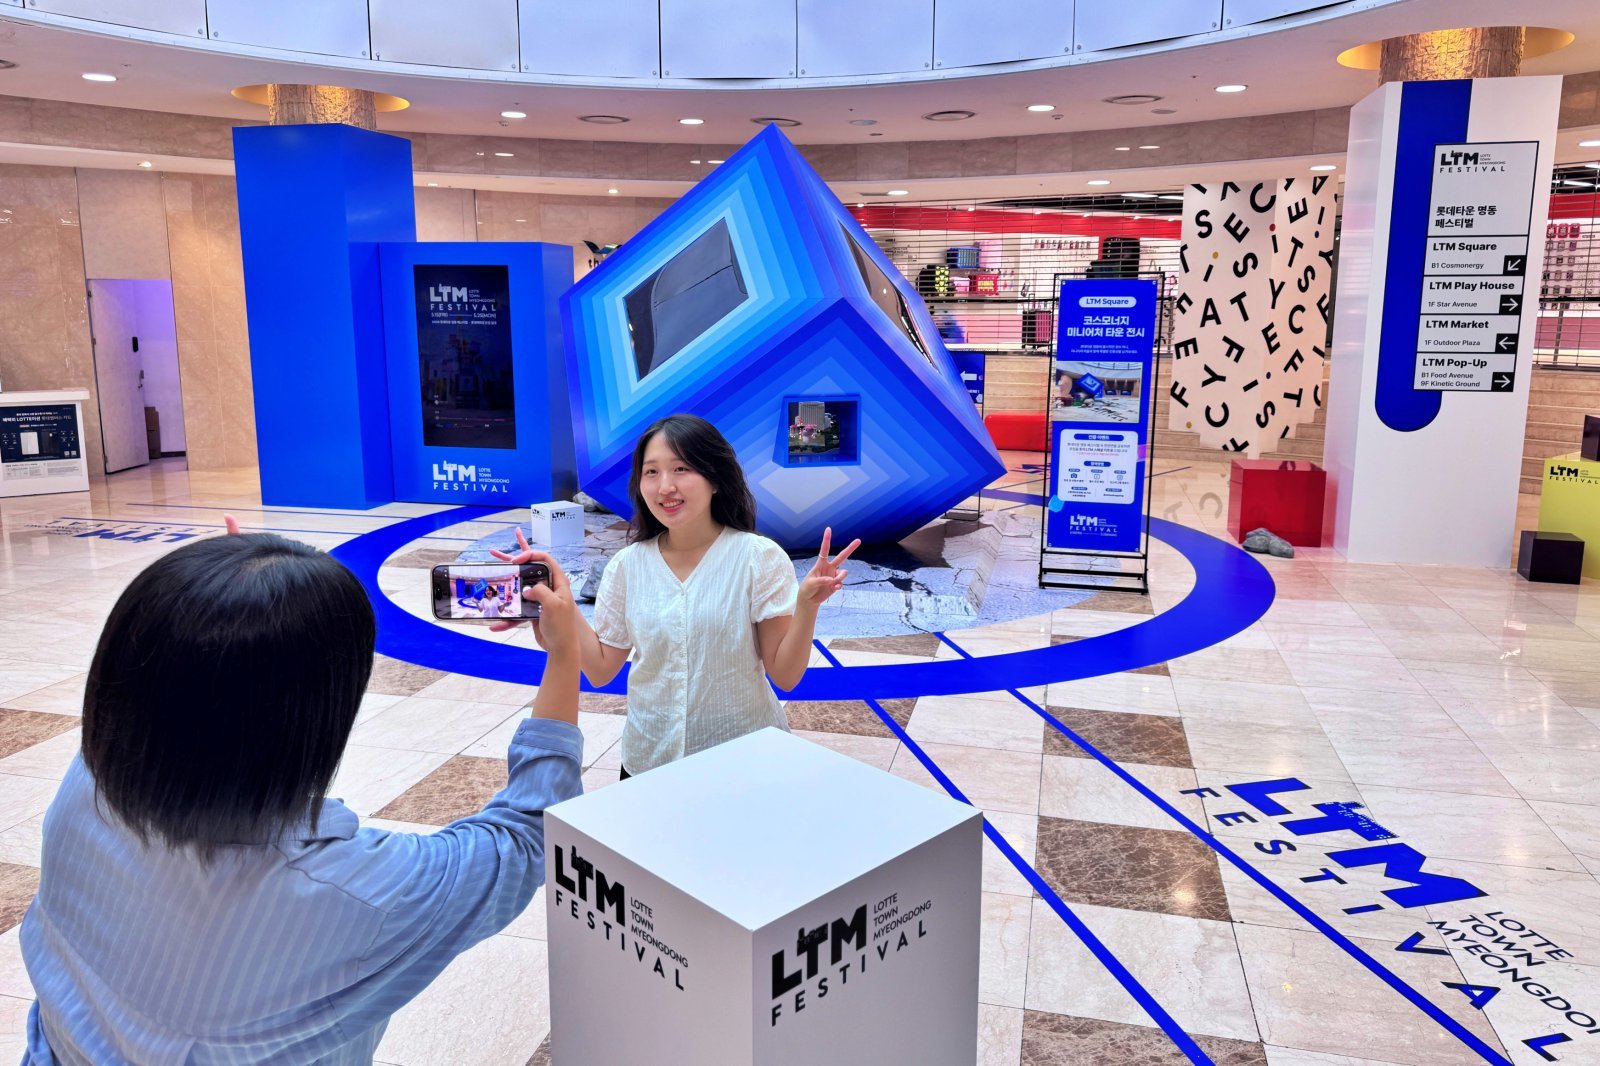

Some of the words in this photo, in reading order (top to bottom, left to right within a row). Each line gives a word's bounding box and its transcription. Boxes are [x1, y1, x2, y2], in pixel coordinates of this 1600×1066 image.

[1440, 150, 1479, 166] LTM
[1436, 206, 1476, 216] 롯데타운
[1477, 205, 1498, 216] 명동
[1435, 218, 1474, 228] 페스티벌
[1433, 242, 1456, 251] LTM
[1458, 243, 1497, 252] Square
[1441, 262, 1484, 270] Cosmonergy
[429, 283, 468, 302] LTM
[1430, 282, 1452, 290] LTM
[1454, 282, 1477, 291] Play
[1480, 282, 1515, 290] House
[1102, 298, 1129, 306] Square
[1083, 316, 1130, 325] 코스모너지
[1426, 321, 1448, 329] LTM
[1450, 320, 1489, 329] Market
[1067, 327, 1103, 337] 미니어처
[1105, 328, 1124, 337] 타운
[1126, 328, 1145, 337] 전시
[1422, 358, 1445, 367] LTM
[1447, 358, 1487, 369] Pop-Up
[432, 460, 476, 482] LTM
[1550, 465, 1578, 477] LTM
[434, 482, 508, 492] FESTIVAL
[1550, 476, 1598, 485] FESTIVAL
[1070, 514, 1098, 526] LTM
[1070, 525, 1117, 533] FESTIVAL
[1224, 777, 1490, 908] LTM
[555, 844, 626, 927] LTM
[630, 896, 653, 918] LOTTE
[873, 892, 898, 914] LOTTE
[630, 910, 654, 932] TOWN
[873, 906, 898, 927] TOWN
[873, 900, 932, 941] MYEONGDONG
[1179, 786, 1573, 1062] FESTIVAL
[556, 890, 684, 991] FESTIVAL
[1459, 914, 1547, 967] TOWN
[1484, 911, 1574, 962] LOTTE
[631, 925, 688, 968] MYEONGDONG
[772, 903, 867, 1000] LTM
[772, 920, 927, 1027] FESTIVAL
